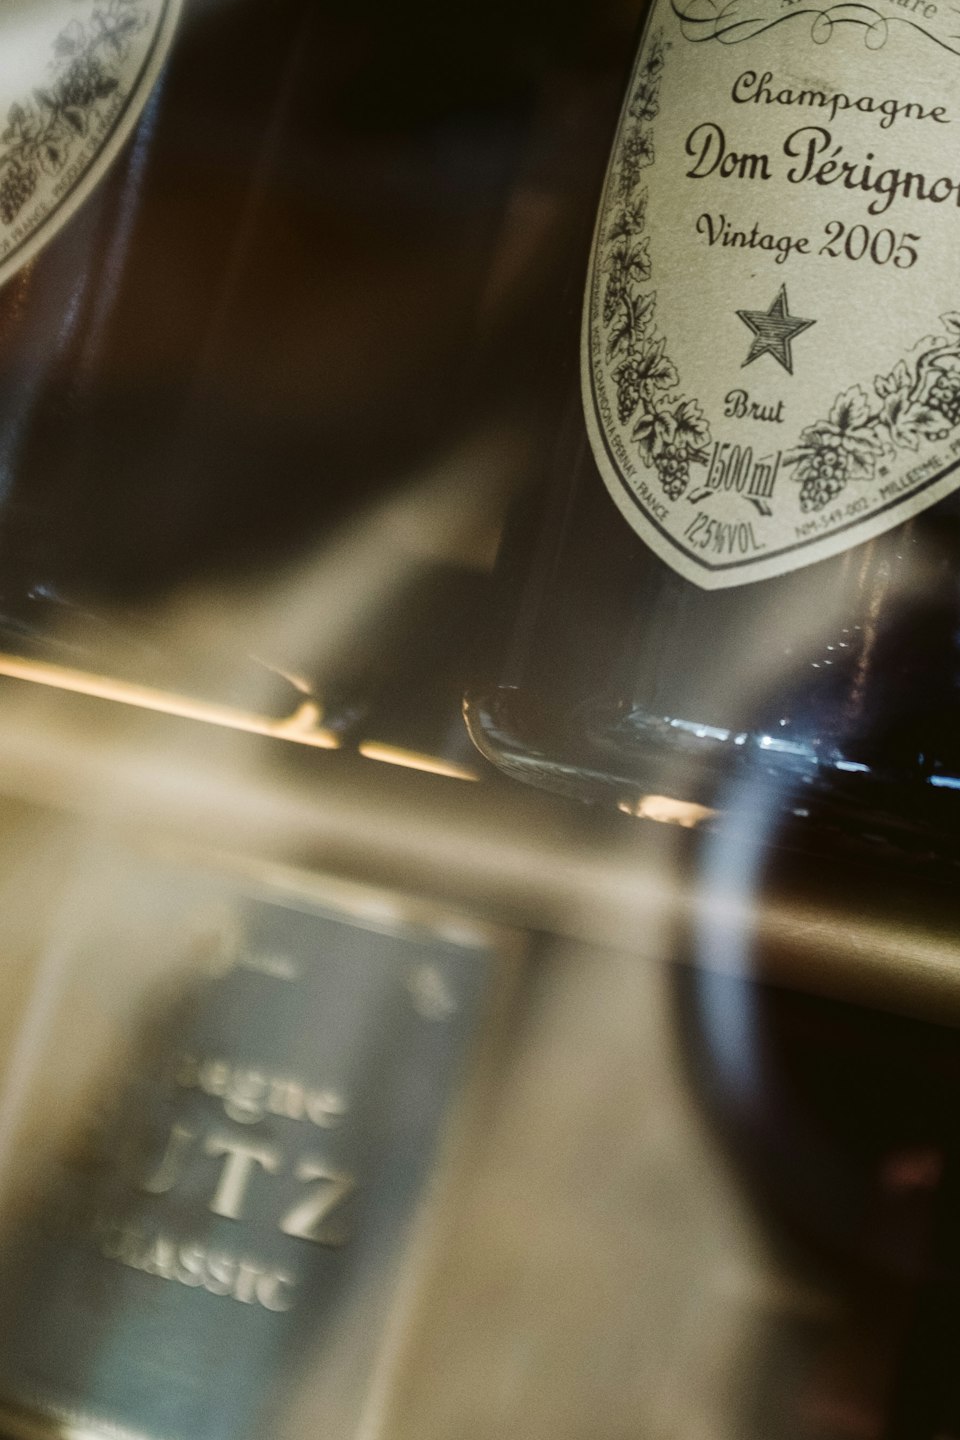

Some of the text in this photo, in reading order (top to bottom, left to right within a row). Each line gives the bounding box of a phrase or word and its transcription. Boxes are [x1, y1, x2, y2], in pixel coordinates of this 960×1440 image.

[732, 70, 951, 129] Champagne
[685, 122, 772, 179] Dom
[696, 213, 922, 269] Vintage 2005
[724, 389, 785, 424] Brut
[636, 481, 670, 521] FRANCE
